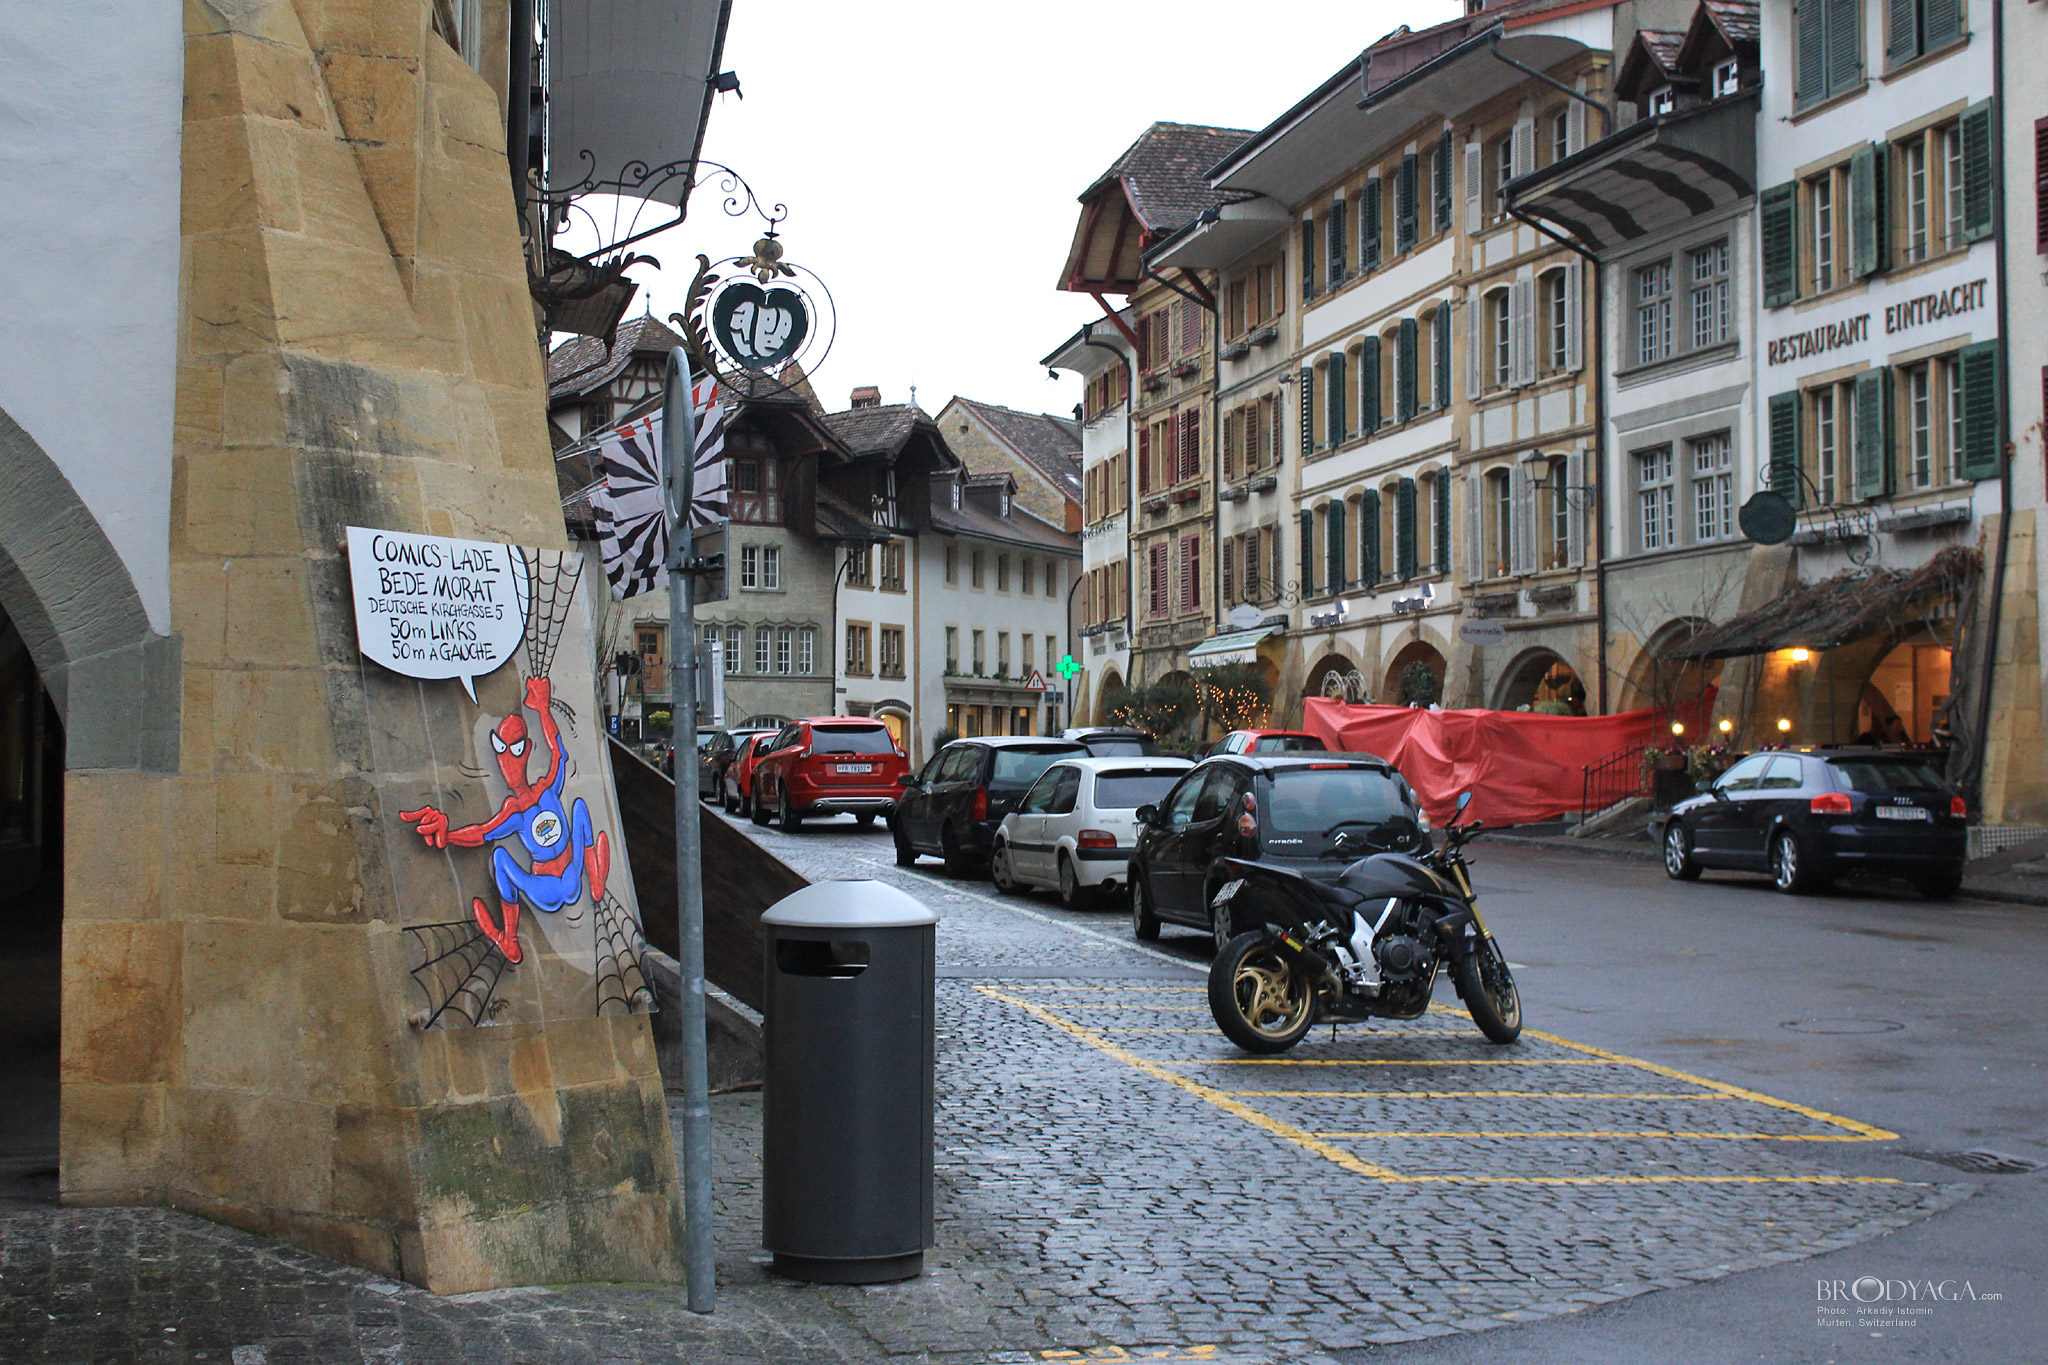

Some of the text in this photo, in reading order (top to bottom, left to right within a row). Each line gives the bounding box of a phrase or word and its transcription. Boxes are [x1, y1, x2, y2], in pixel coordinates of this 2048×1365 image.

[1767, 278, 1988, 366] RESTAURANT EINTRACHT
[372, 535, 500, 573] COMICS-LADE
[378, 567, 497, 603] BEDE MORAT
[368, 597, 504, 620] DEUTSCHE KIRCHGASSE 5
[430, 619, 477, 641] LINKS
[439, 642, 497, 662] GAUCHE
